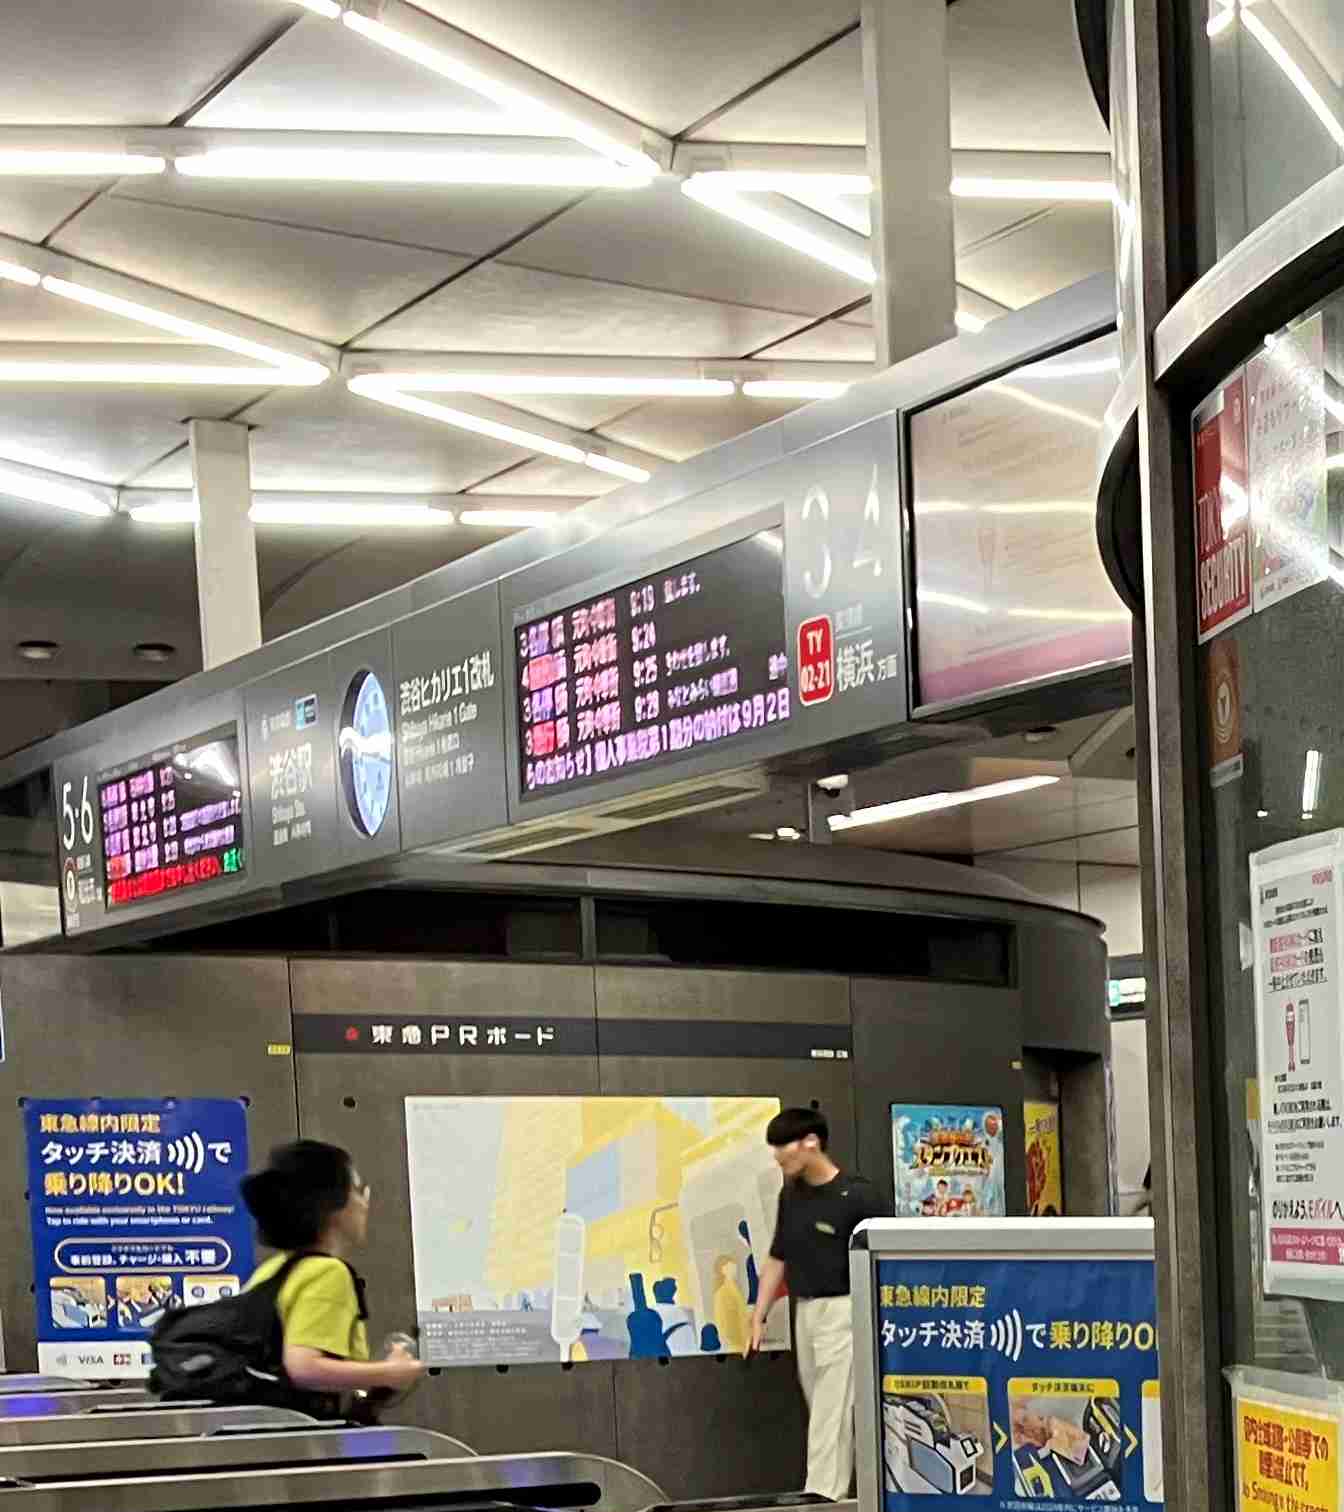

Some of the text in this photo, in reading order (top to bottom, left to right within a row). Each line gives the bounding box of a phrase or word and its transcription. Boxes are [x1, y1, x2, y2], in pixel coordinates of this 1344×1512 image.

[806, 629, 824, 655] TY
[836, 640, 874, 692] 横浜
[400, 650, 494, 716] 渋谷ヒカリエ1改札
[40, 1114, 160, 1133] 東急線内限定
[41, 1141, 232, 1165] タッチ決済 で
[44, 1172, 184, 1196] 乗り降りOK!
[880, 1285, 986, 1308] 東急線内限定
[881, 1318, 985, 1349] タッチ決済
